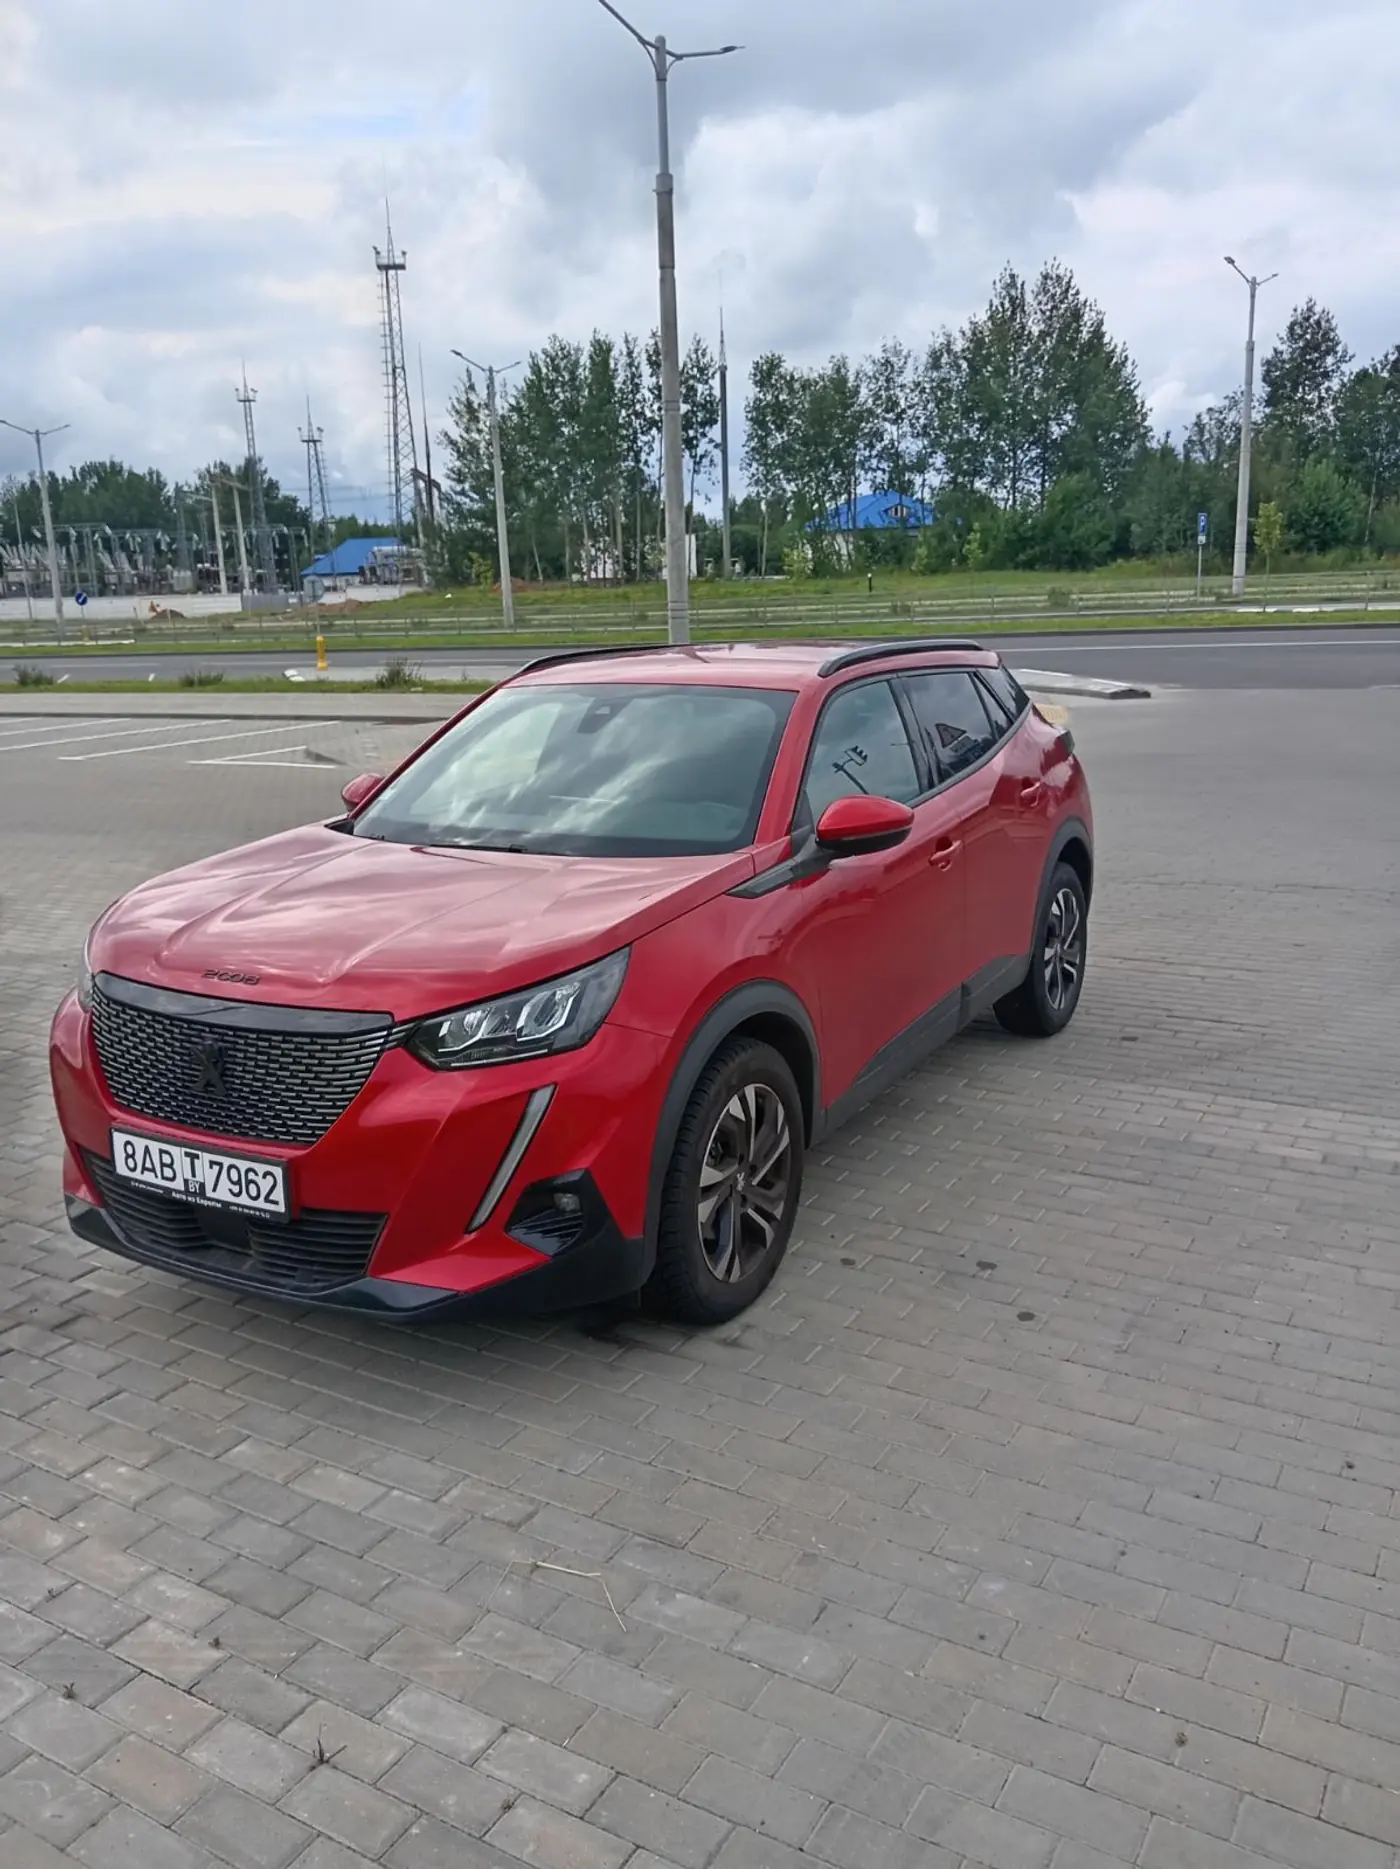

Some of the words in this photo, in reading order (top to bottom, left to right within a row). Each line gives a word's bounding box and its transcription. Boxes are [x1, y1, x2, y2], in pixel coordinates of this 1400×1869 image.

[201, 969, 261, 986] 2008
[123, 1139, 177, 1183] 8AB
[183, 1151, 200, 1179] T
[208, 1159, 280, 1206] 7962
[188, 1179, 200, 1194] BY
